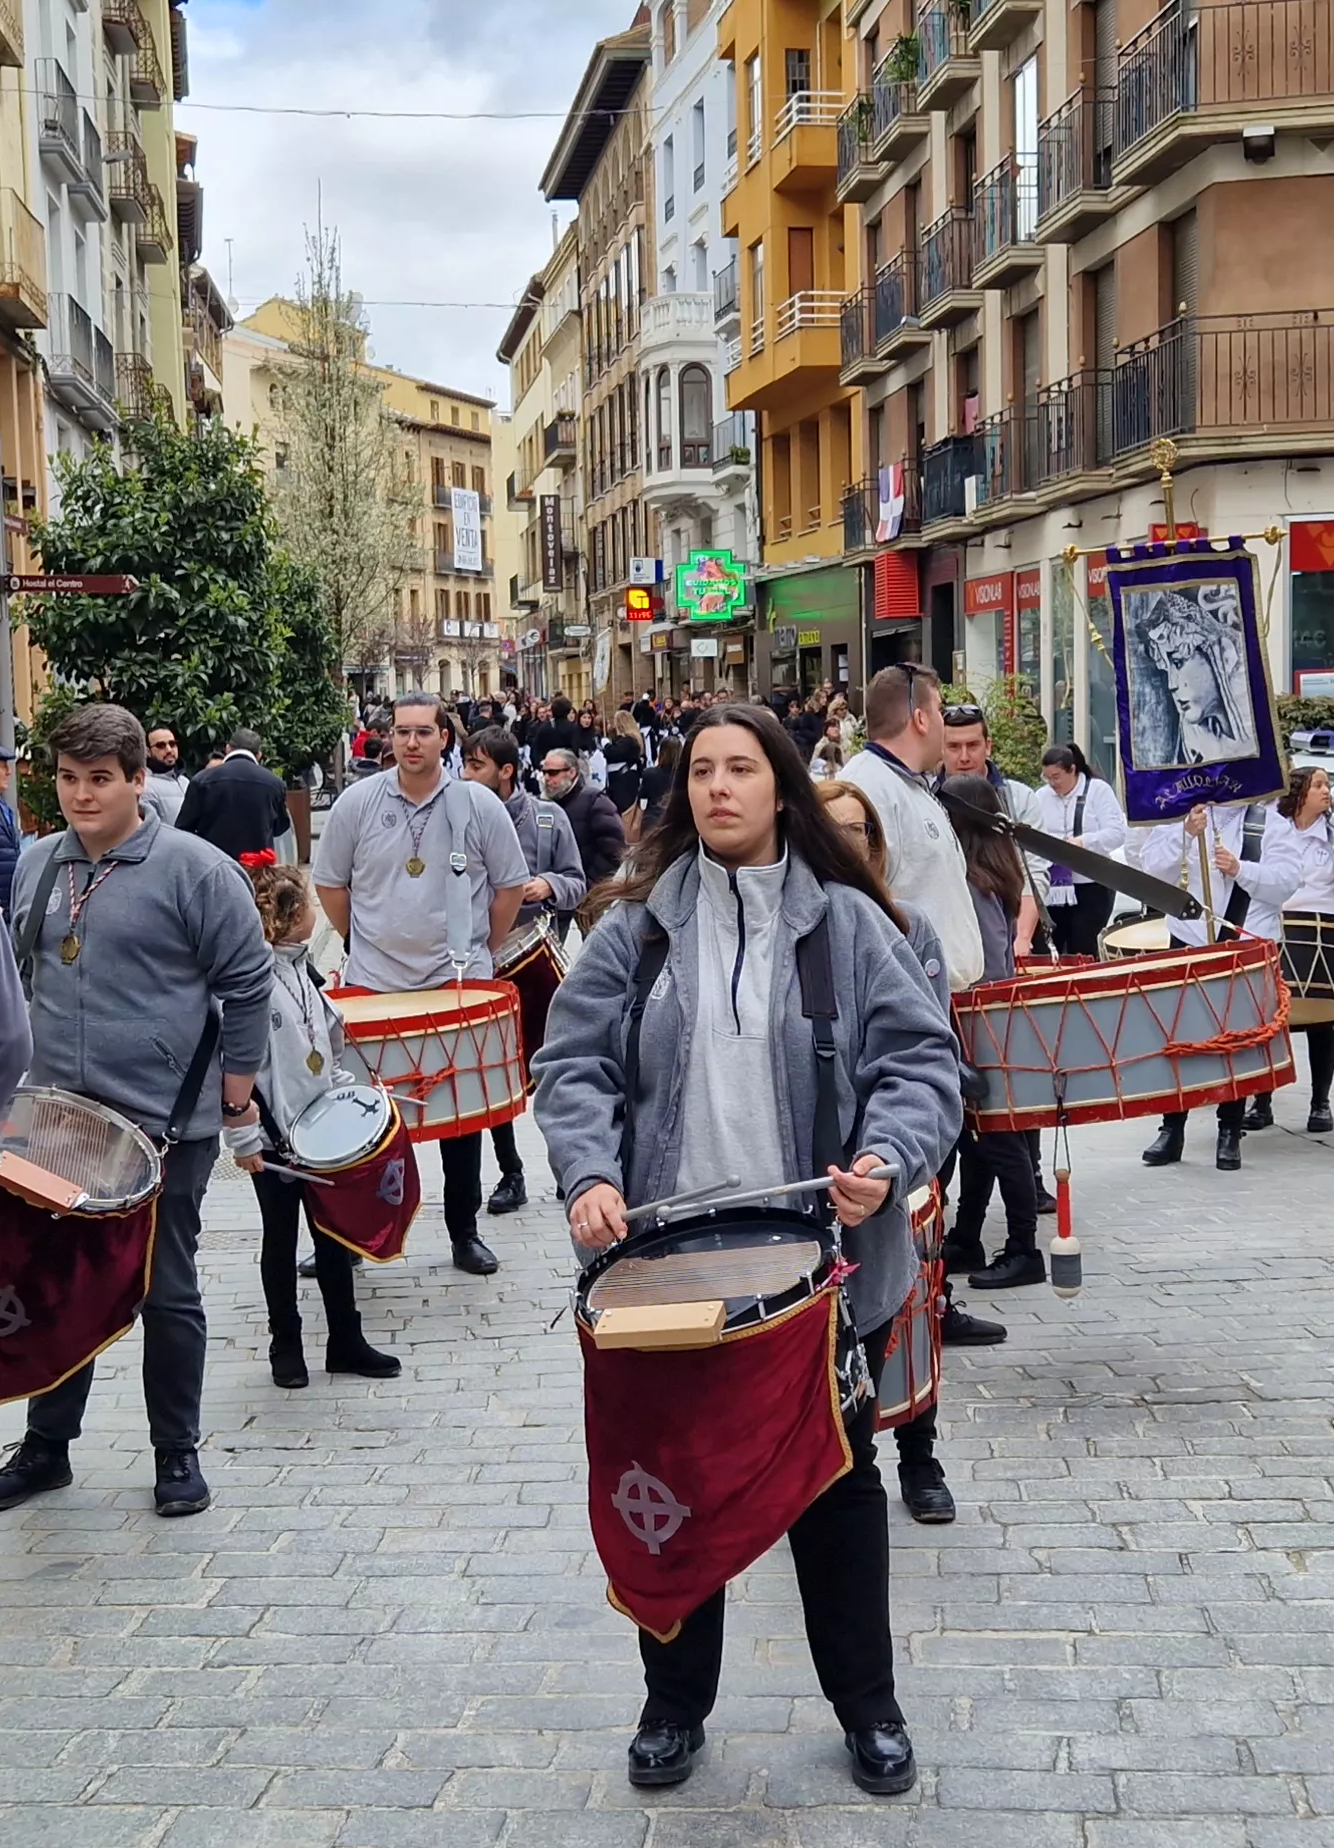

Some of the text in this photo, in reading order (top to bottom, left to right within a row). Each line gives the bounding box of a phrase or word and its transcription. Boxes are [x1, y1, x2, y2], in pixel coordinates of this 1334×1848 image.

[463, 511, 471, 526] EN
[456, 527, 478, 549] VENTA
[22, 578, 83, 588] Hostal el Centro
[975, 582, 1002, 604] VISIONLAB
